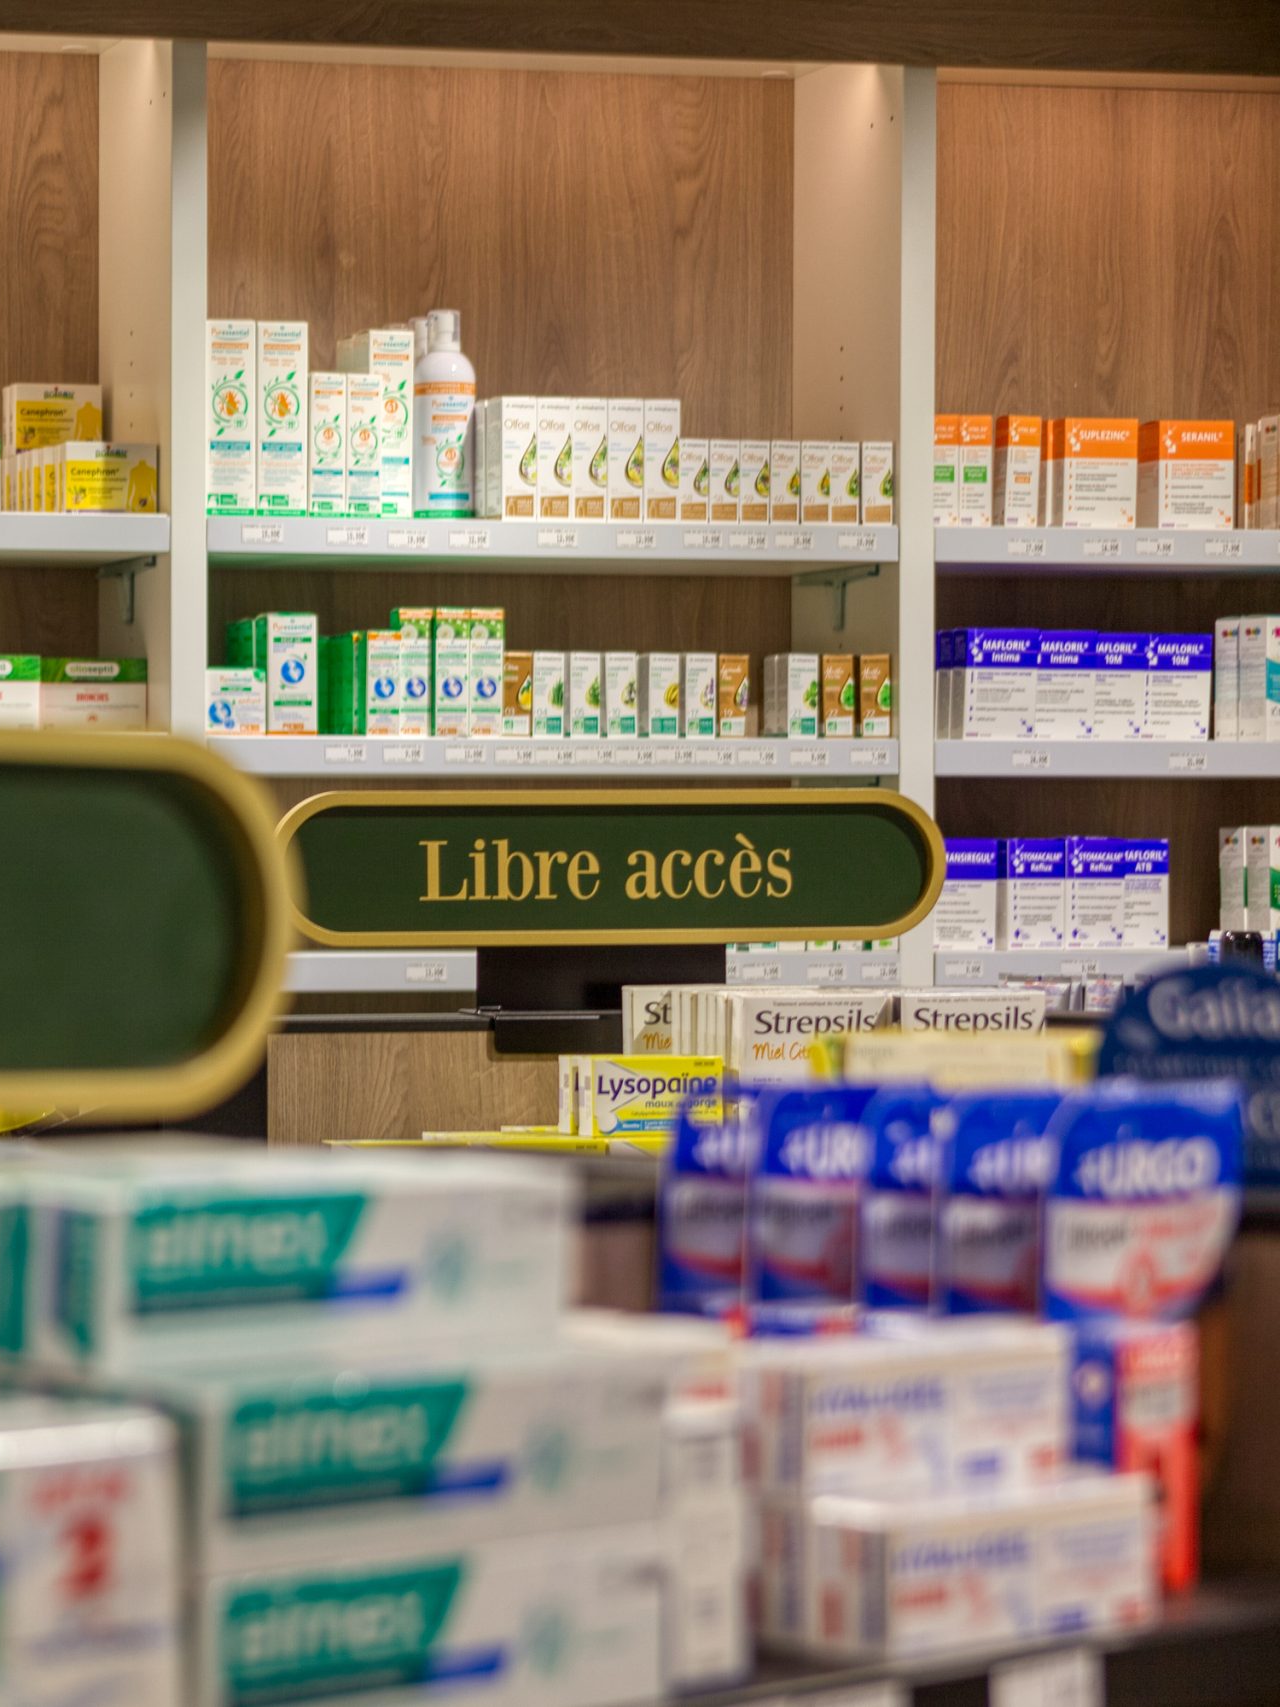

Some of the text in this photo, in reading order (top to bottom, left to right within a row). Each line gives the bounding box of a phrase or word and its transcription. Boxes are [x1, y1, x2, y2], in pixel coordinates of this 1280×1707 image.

[1079, 429, 1126, 442] SUPLEZINC
[1181, 431, 1219, 443] SERANIL
[982, 640, 1026, 652] MAFLORIL
[1040, 641, 1083, 653] MAFLORIL
[1157, 643, 1200, 655] MAFLORIL
[991, 651, 1021, 663] Intima
[1050, 653, 1079, 664] Intima
[946, 851, 990, 863] ANSIREGUL
[419, 833, 793, 902] Libre accès
[754, 1008, 875, 1036] Strepsils
[913, 1006, 1033, 1034] Strepsils
[642, 1031, 673, 1051] Mie
[753, 1041, 785, 1061] Miel
[597, 1072, 717, 1101] Lysopaïne
[644, 1100, 673, 1109] maux
